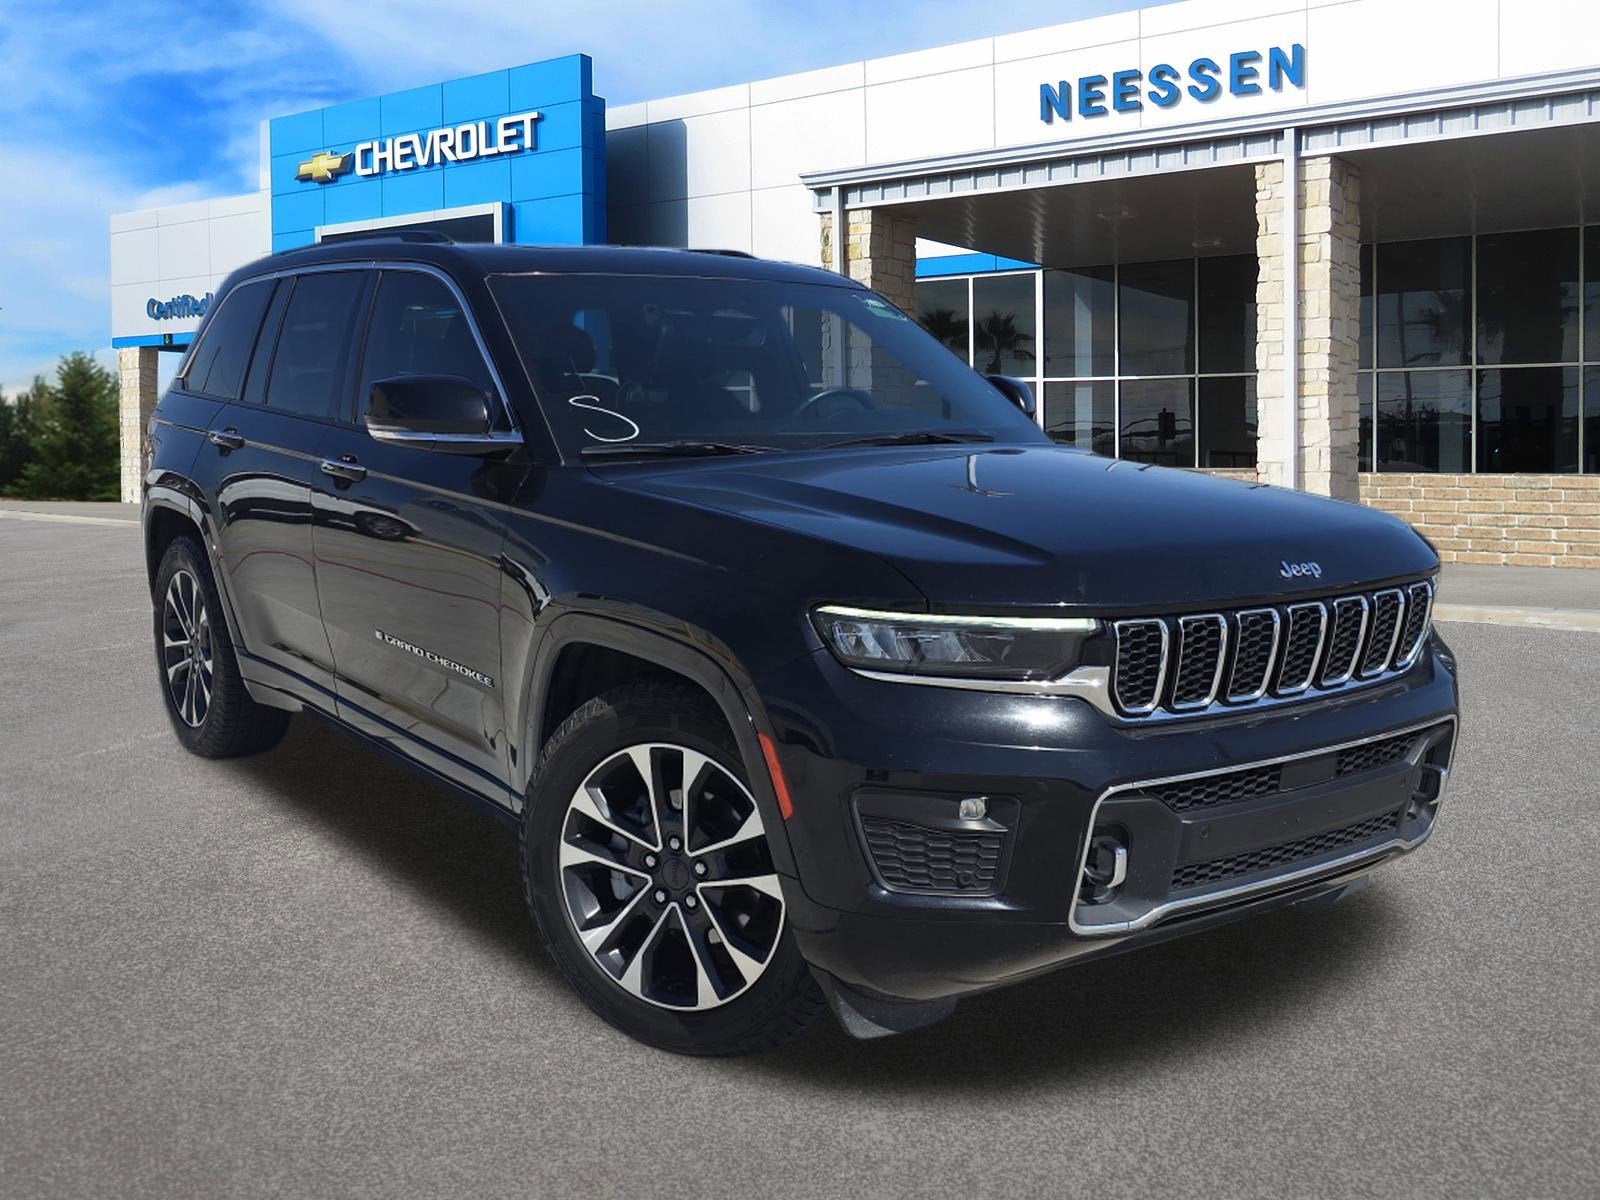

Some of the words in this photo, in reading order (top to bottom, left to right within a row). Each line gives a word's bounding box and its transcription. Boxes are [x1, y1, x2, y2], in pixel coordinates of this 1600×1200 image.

[1040, 43, 1306, 125] NEESSEN
[354, 111, 542, 178] CHEVROLET
[146, 292, 213, 320] Certified
[1280, 560, 1322, 578] Jeep
[384, 633, 425, 657] GRAND
[425, 651, 496, 688] CHEROKEE
